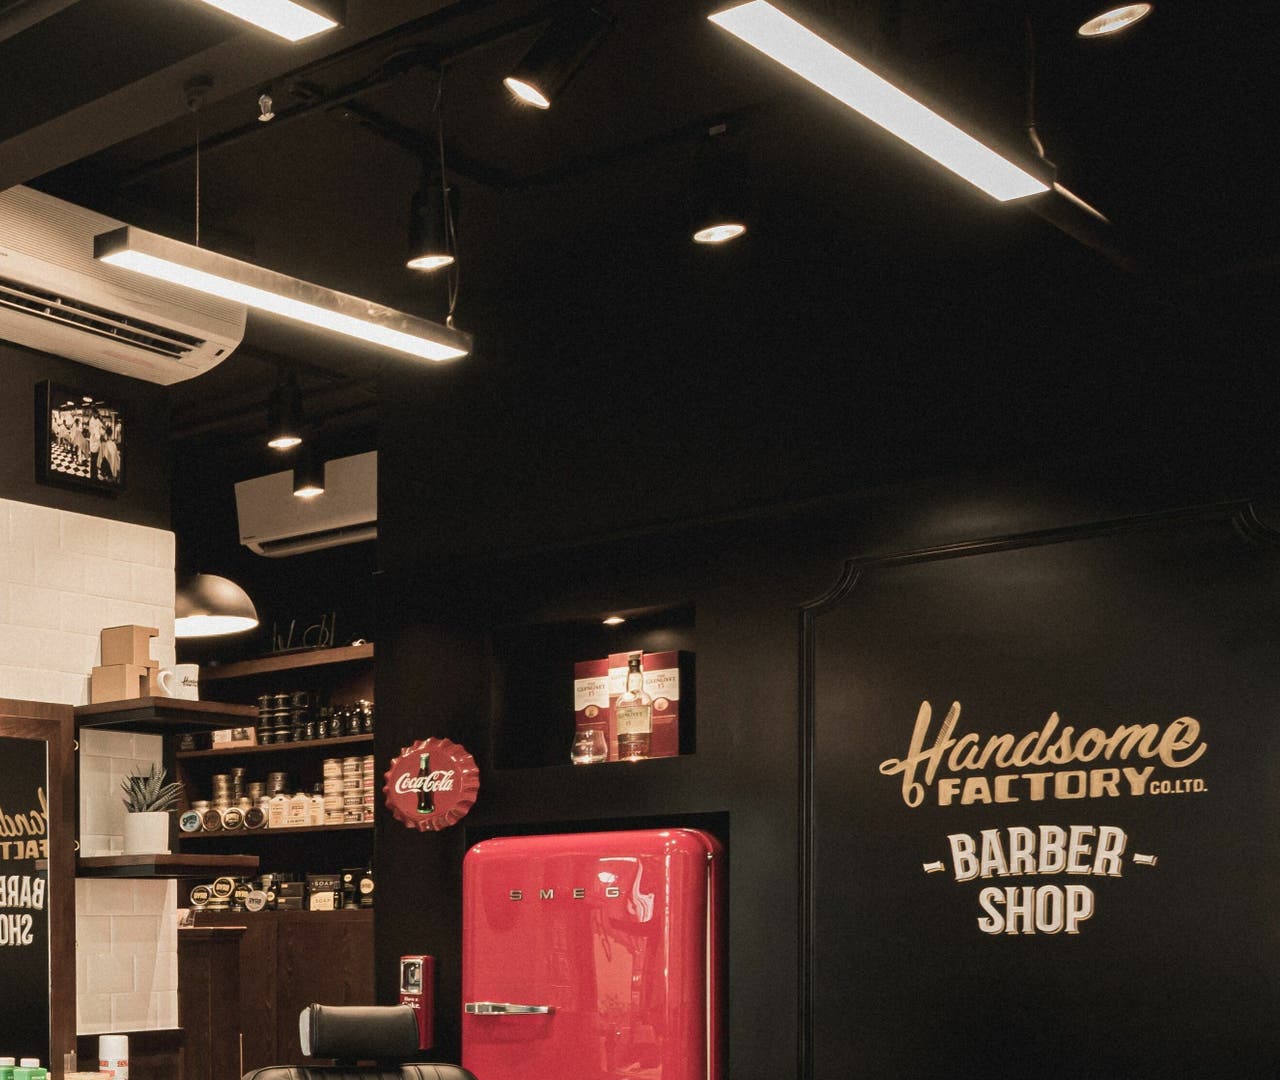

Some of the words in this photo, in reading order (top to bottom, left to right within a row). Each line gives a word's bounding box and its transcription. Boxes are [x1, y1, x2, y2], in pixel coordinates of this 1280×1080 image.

[879, 700, 1208, 808] Handsome
[394, 769, 456, 794] Coca-Cola
[937, 766, 1155, 806] FACTORY
[509, 886, 620, 901] SMEG
[977, 884, 1095, 935] SHOP
